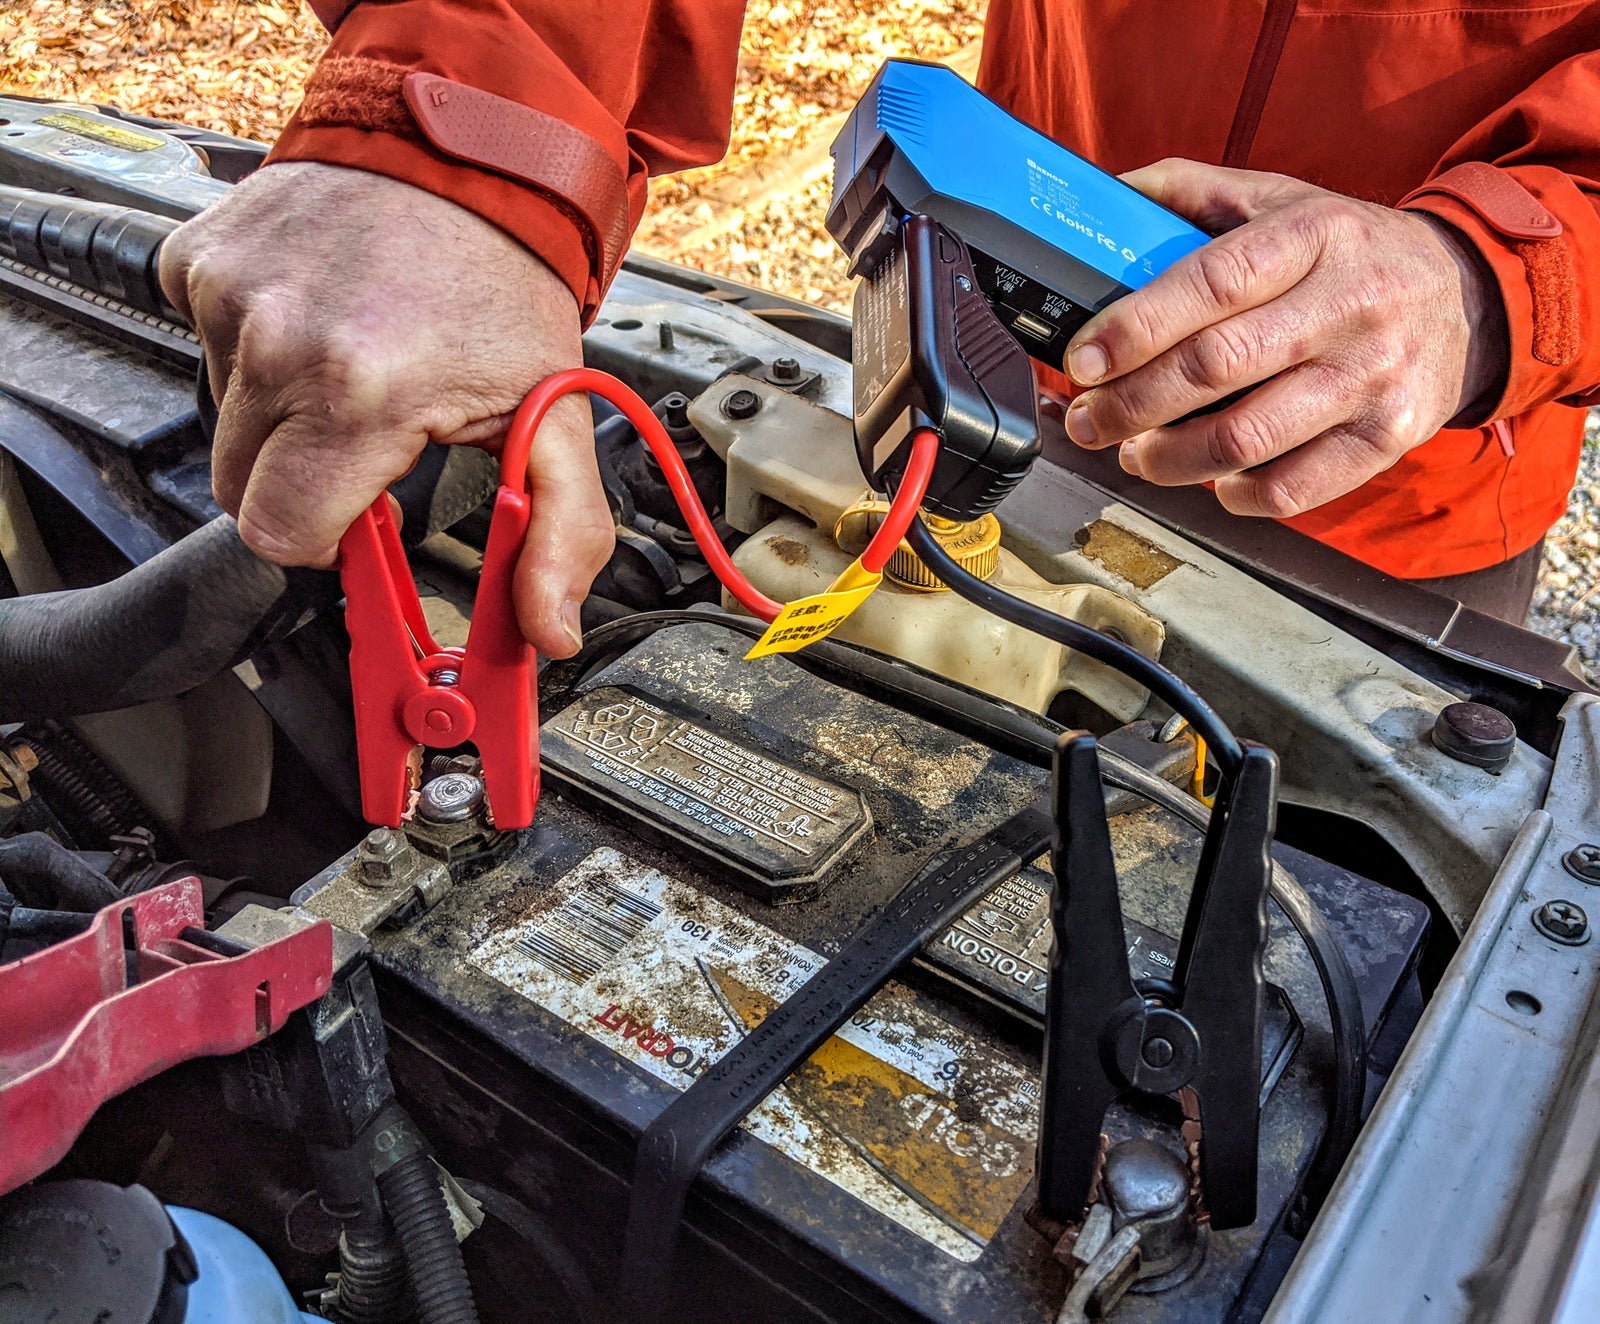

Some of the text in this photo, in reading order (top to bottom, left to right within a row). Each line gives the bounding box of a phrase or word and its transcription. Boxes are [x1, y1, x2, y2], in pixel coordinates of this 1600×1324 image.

[1056, 210, 1094, 238] RoHS
[1097, 231, 1117, 252] FC
[995, 265, 1028, 288] 15V/1A
[1045, 293, 1073, 312] 5V/1A
[626, 695, 664, 715] RECYCLE
[617, 746, 644, 757] LEAD
[673, 736, 706, 754] FOLLOW
[728, 745, 761, 763] SERVICE
[582, 748, 608, 762] LEVEL
[702, 750, 740, 770] STARTING
[711, 745, 745, 764] OWNERS
[603, 758, 624, 770] AND
[736, 766, 760, 780] JUMP
[741, 759, 774, 778] VEHICLE
[758, 759, 780, 772] SEEK
[621, 767, 647, 782] TIGHT
[757, 776, 779, 789] SAFE
[770, 773, 783, 782] IN
[777, 767, 817, 789] AVAILABLE
[644, 778, 668, 793] CAPS
[693, 761, 790, 812] MEDICAL HELP FAST
[776, 784, 795, 797] FOR
[780, 778, 834, 806] INSTRUCTIONS
[815, 785, 834, 797] NOT
[589, 760, 735, 836] KEEP OUT OF THE REACH OF CHILDREN
[651, 764, 773, 828] FLUSH EYES IMMEDIATELY
[664, 788, 689, 803] VENT
[695, 773, 781, 819] WITH WATER. GET
[831, 792, 842, 801] IF
[686, 799, 710, 814] KEEP
[724, 818, 745, 832] NOT
[741, 826, 758, 838] DO
[1014, 896, 1037, 910] CAN
[681, 919, 735, 958] Reserve 130
[713, 934, 744, 953] Capacity
[747, 933, 768, 948] VA
[943, 930, 1033, 985] POISON
[755, 961, 791, 983] 875
[872, 1026, 927, 1062] Cold Craing
[900, 1034, 927, 1051] Amps
[900, 1094, 1021, 1177] GOLD
